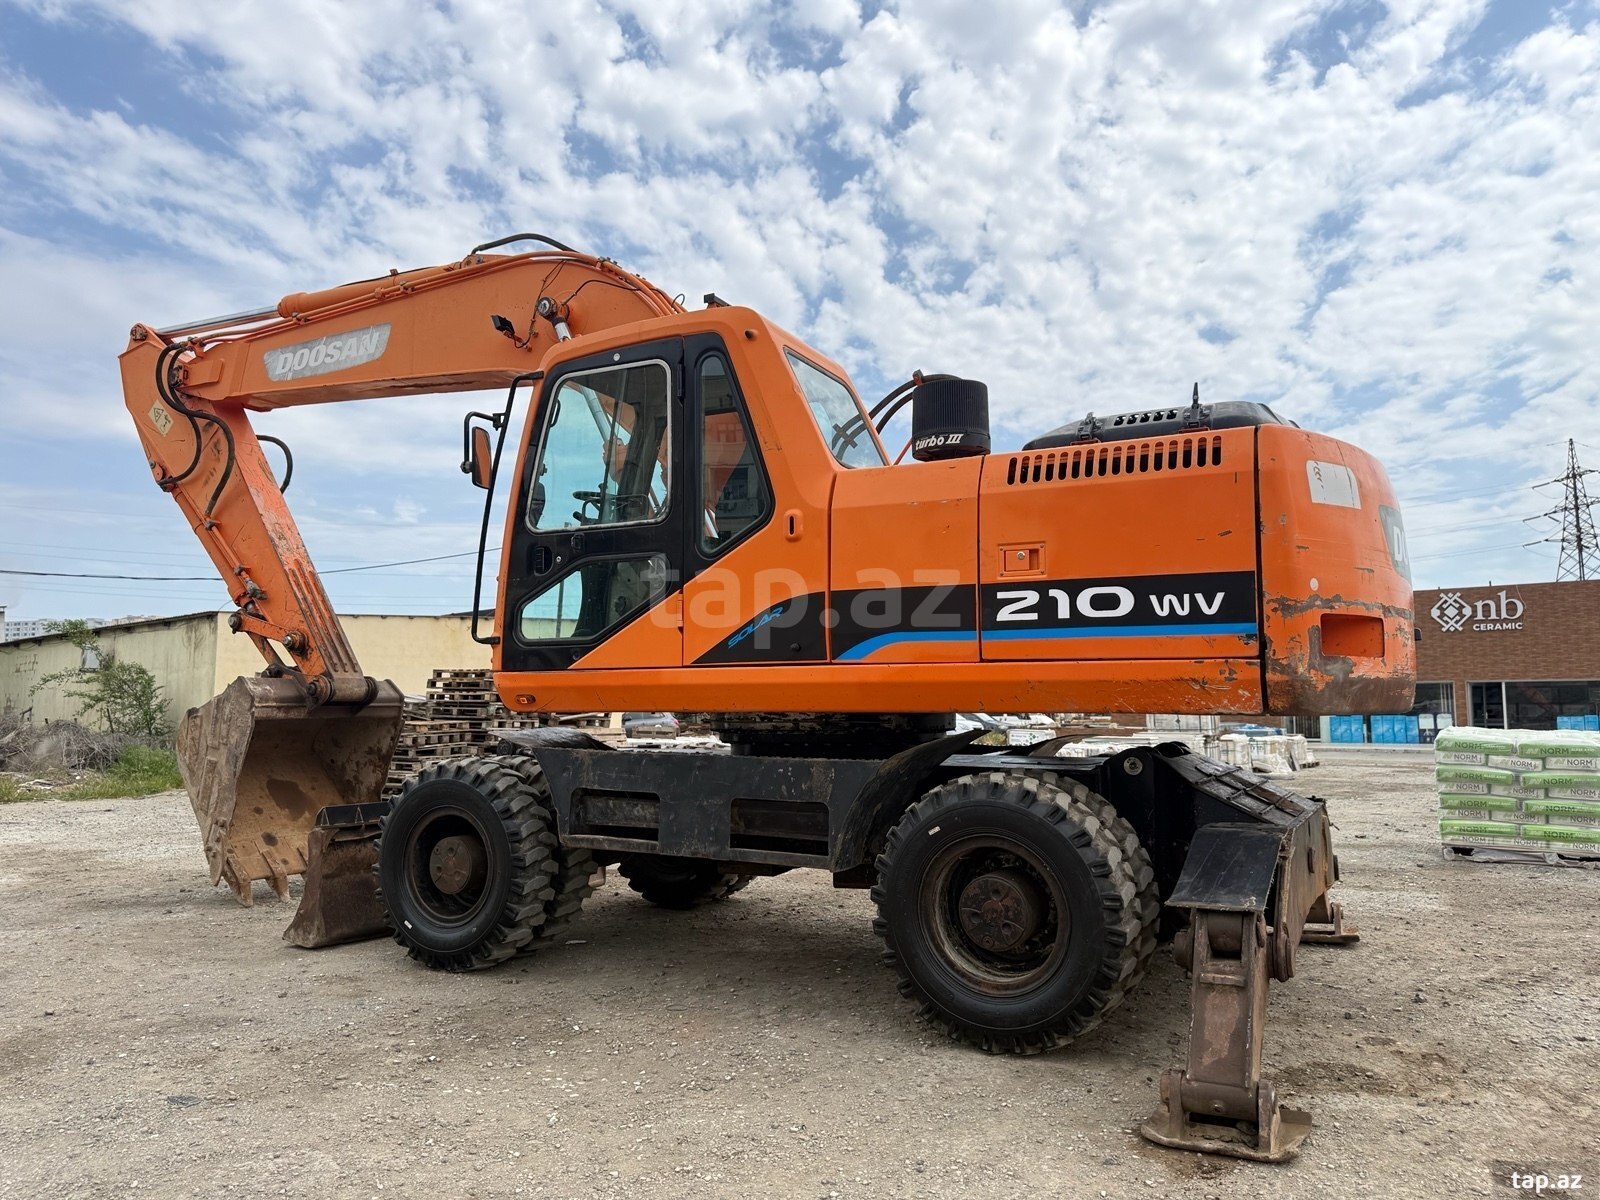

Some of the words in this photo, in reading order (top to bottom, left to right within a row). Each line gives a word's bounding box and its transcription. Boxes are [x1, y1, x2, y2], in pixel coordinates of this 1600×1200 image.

[275, 332, 380, 374] DOOSAN
[916, 436, 944, 450] turbo
[946, 434, 964, 444] III
[996, 586, 1135, 622] 210
[1150, 592, 1226, 616] WV
[1474, 590, 1524, 620] nb
[1473, 622, 1522, 631] CERAMIC
[1544, 831, 1573, 839] NORM
